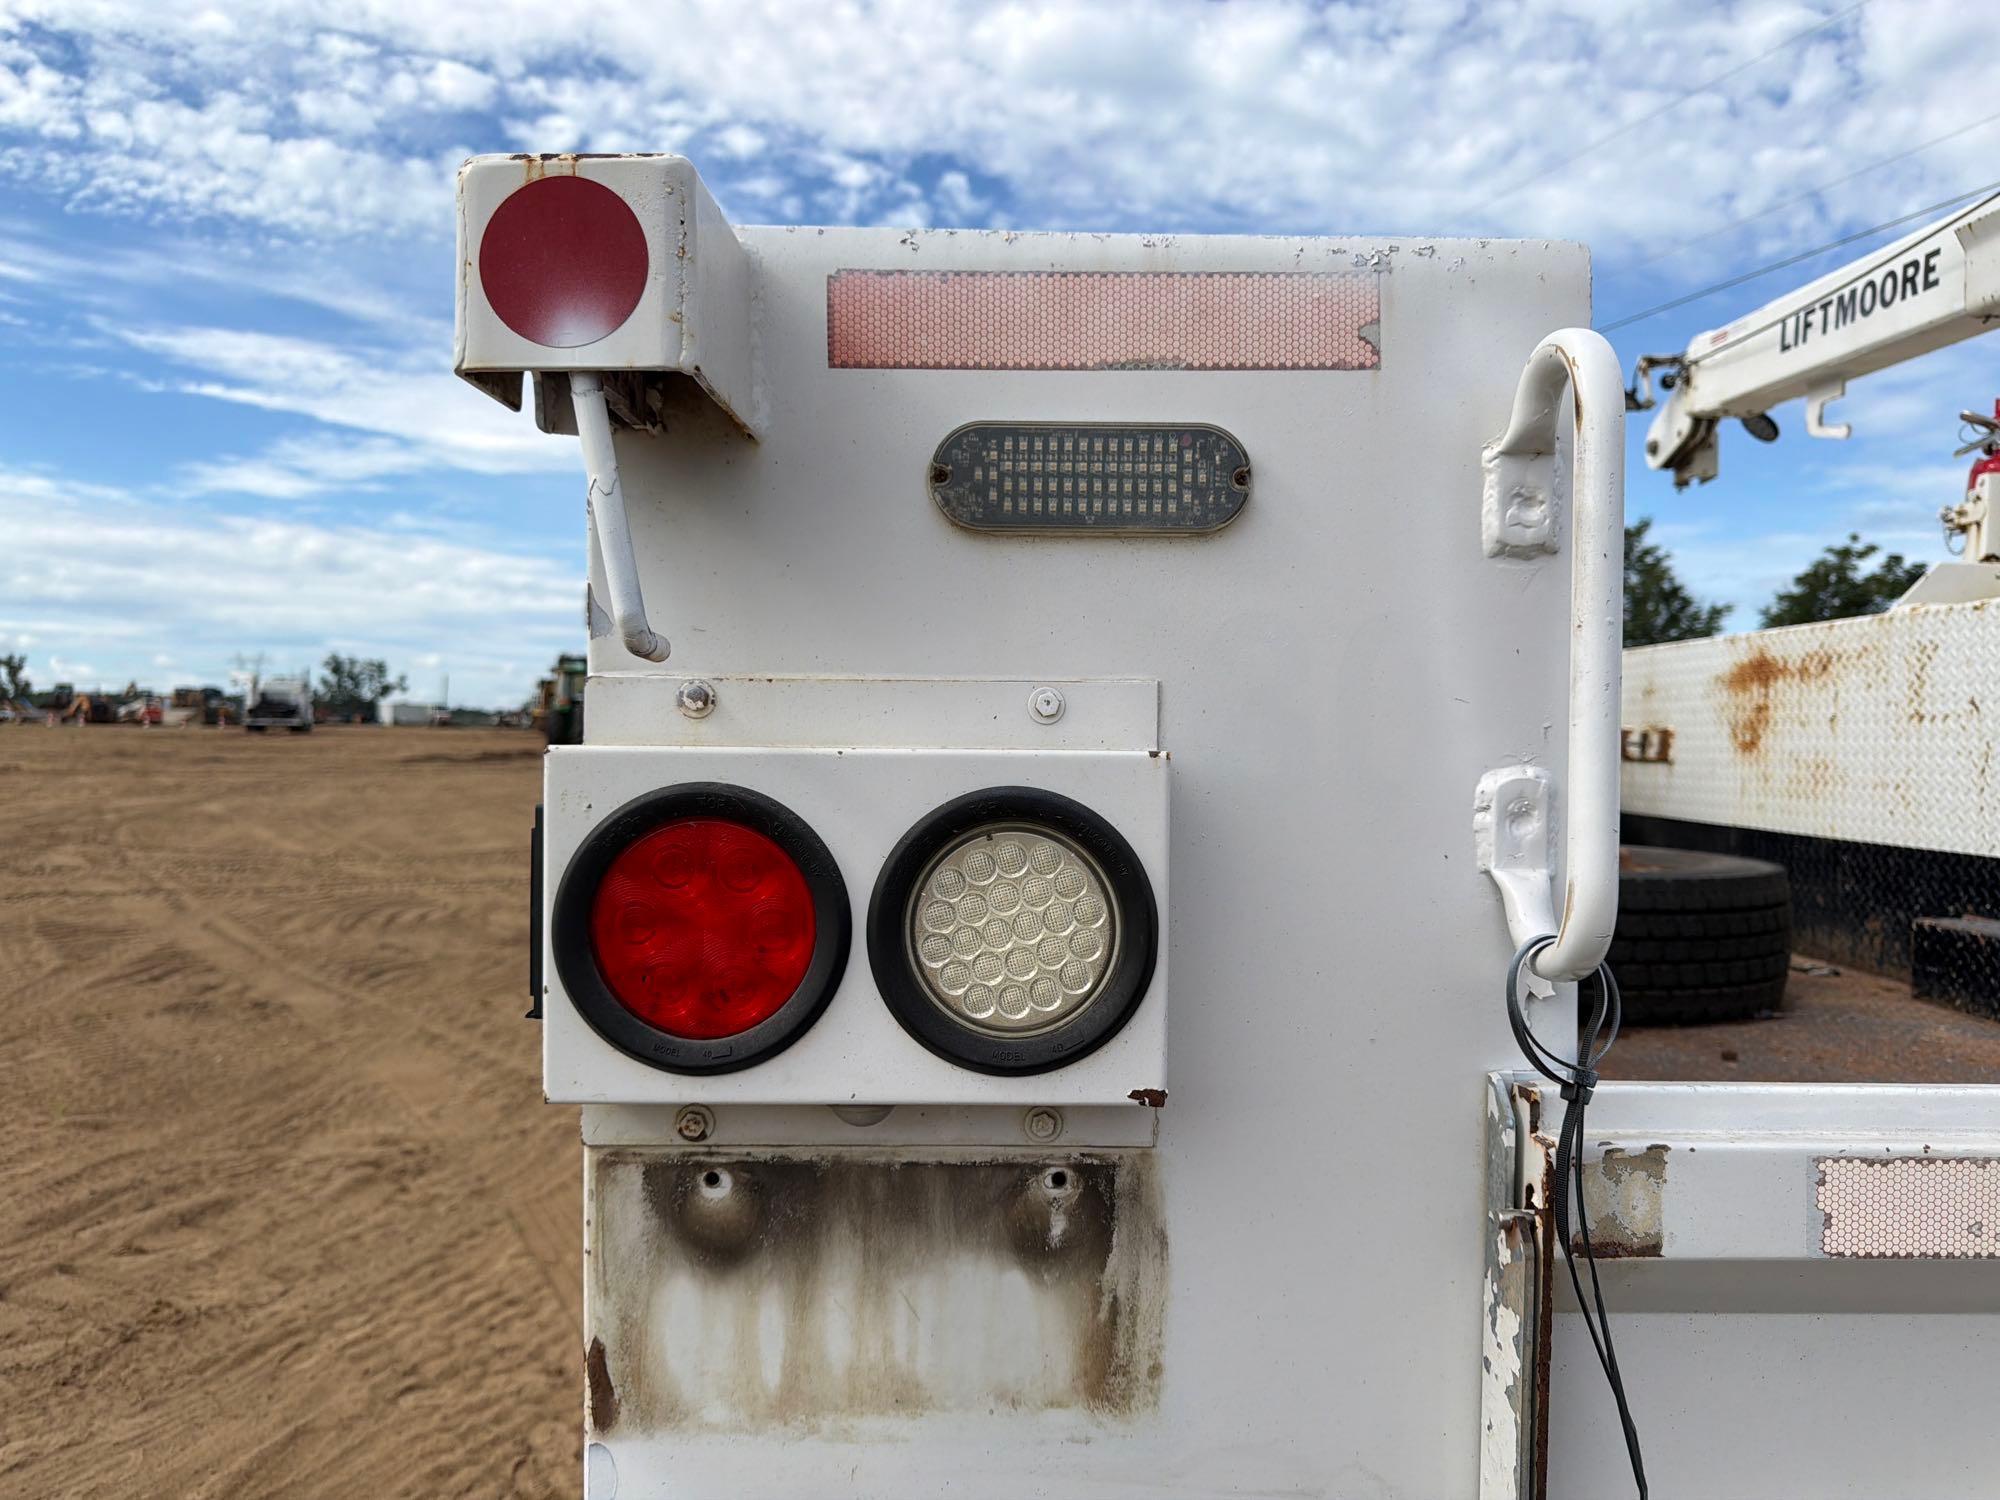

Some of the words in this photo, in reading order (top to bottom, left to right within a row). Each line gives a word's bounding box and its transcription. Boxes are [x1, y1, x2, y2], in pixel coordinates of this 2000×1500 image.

[1780, 248, 1941, 352] LIFTMOORE
[652, 1043, 681, 1058] MODEL
[992, 1050, 1026, 1062] MODEL
